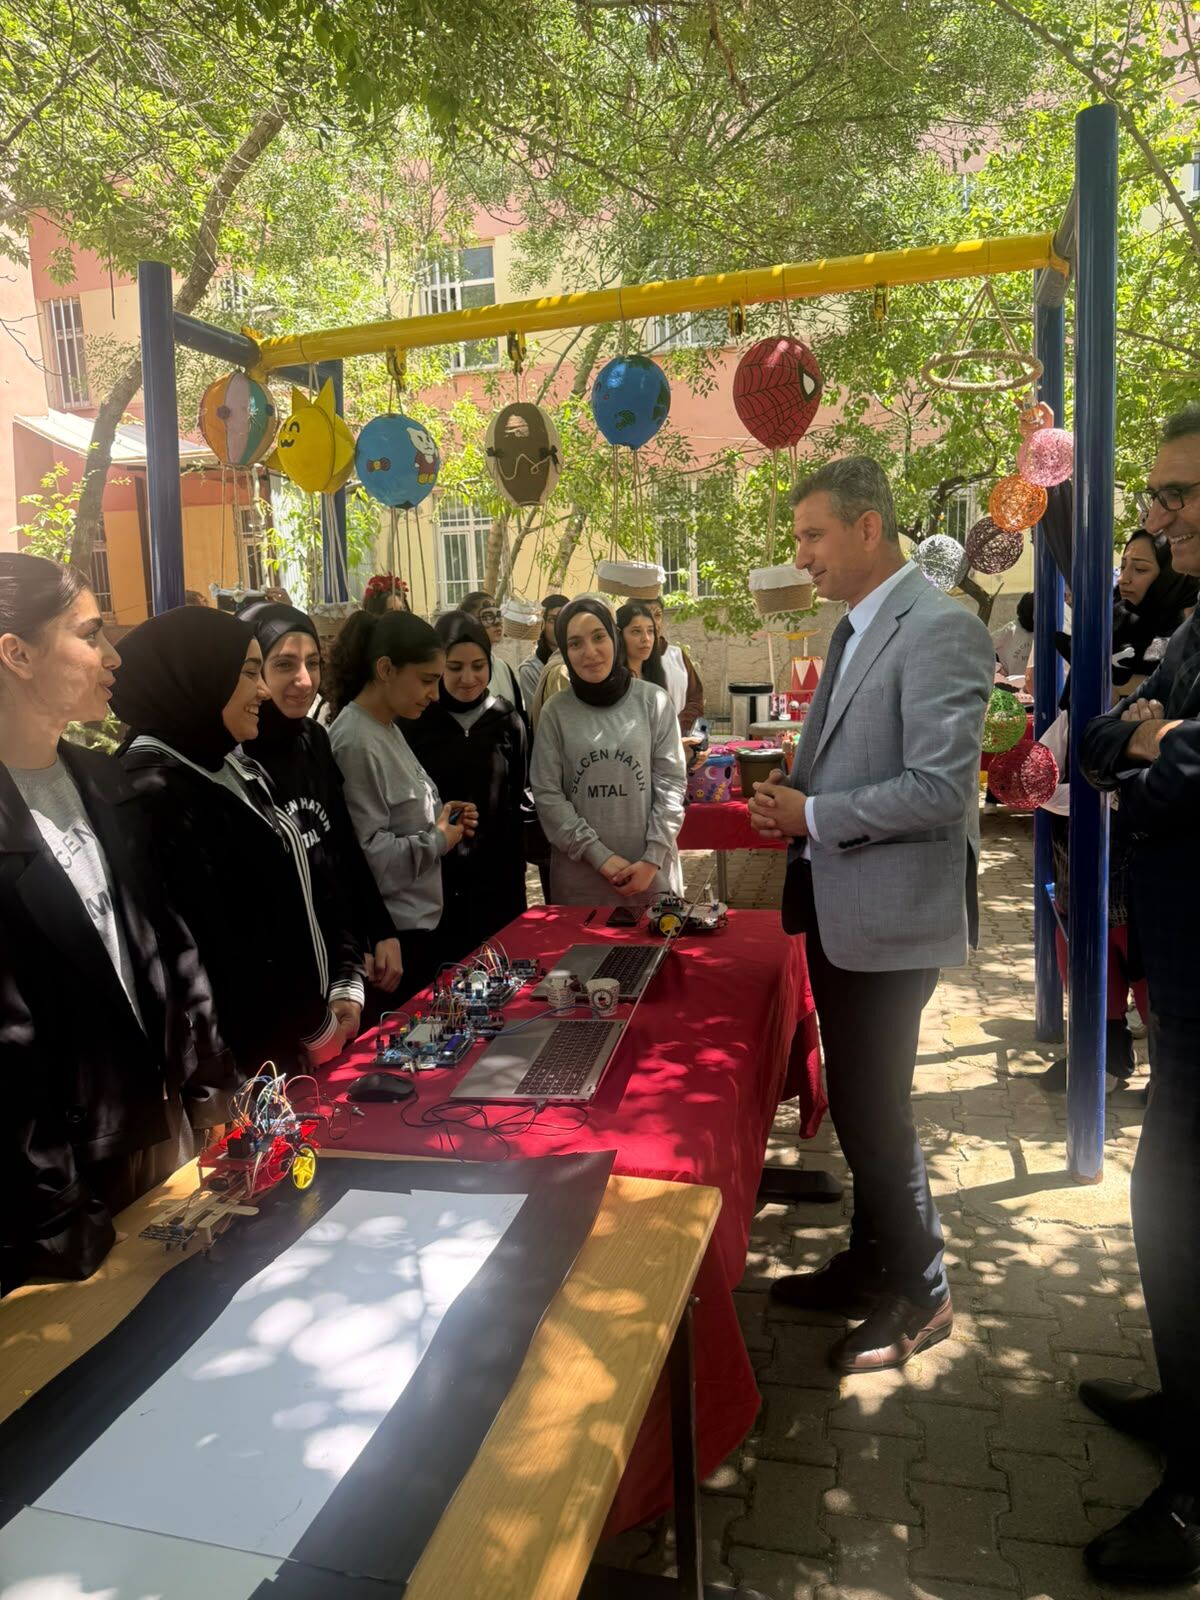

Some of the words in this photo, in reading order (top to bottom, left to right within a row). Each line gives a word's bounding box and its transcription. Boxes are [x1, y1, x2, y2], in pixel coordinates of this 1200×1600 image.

[572, 749, 609, 794] SELCEN
[615, 749, 646, 791] HATUN
[588, 784, 628, 798] MTAL
